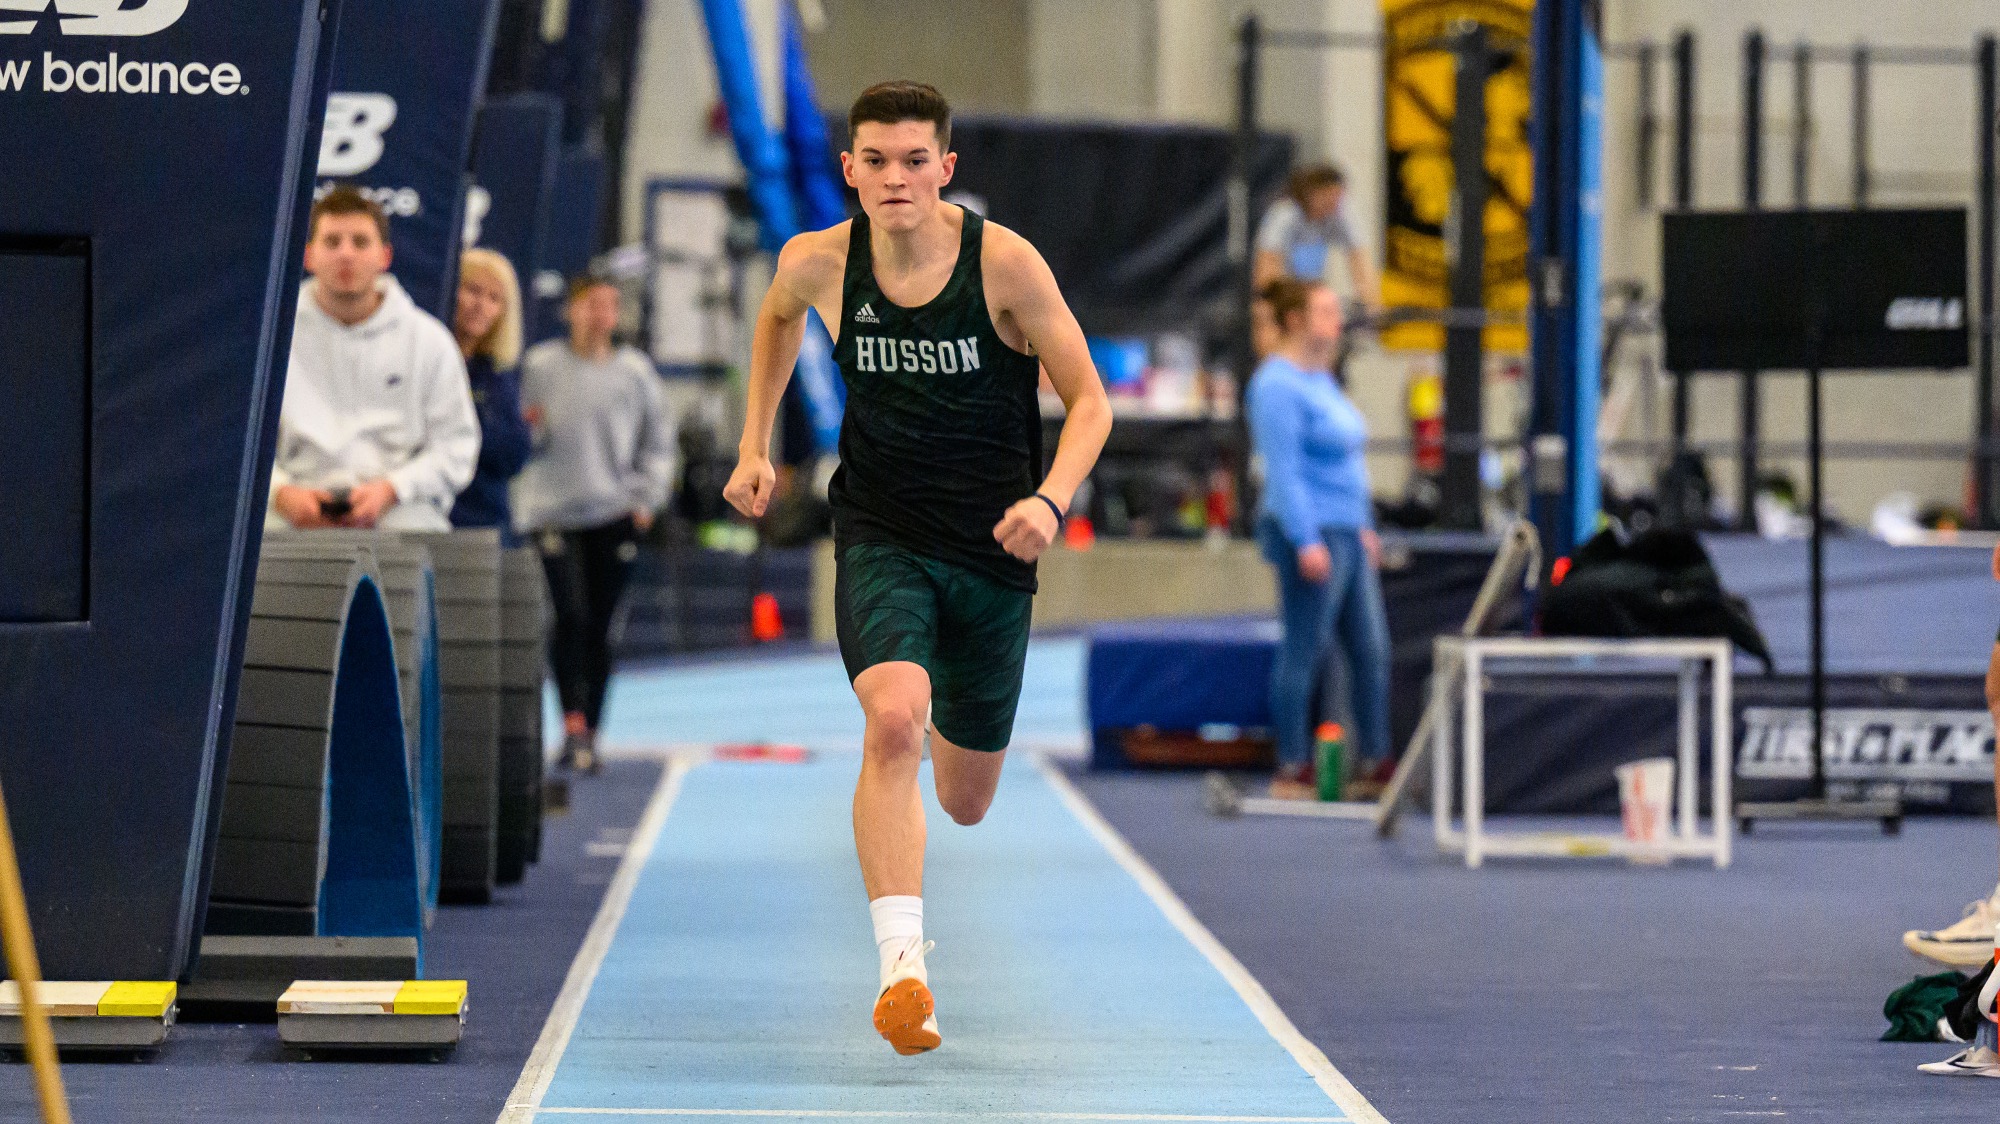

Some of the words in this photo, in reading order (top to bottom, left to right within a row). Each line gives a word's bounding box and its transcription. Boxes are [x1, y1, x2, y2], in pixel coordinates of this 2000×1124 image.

[43, 51, 242, 95] balance
[854, 315, 880, 324] adidas
[855, 336, 981, 374] HUSSON
